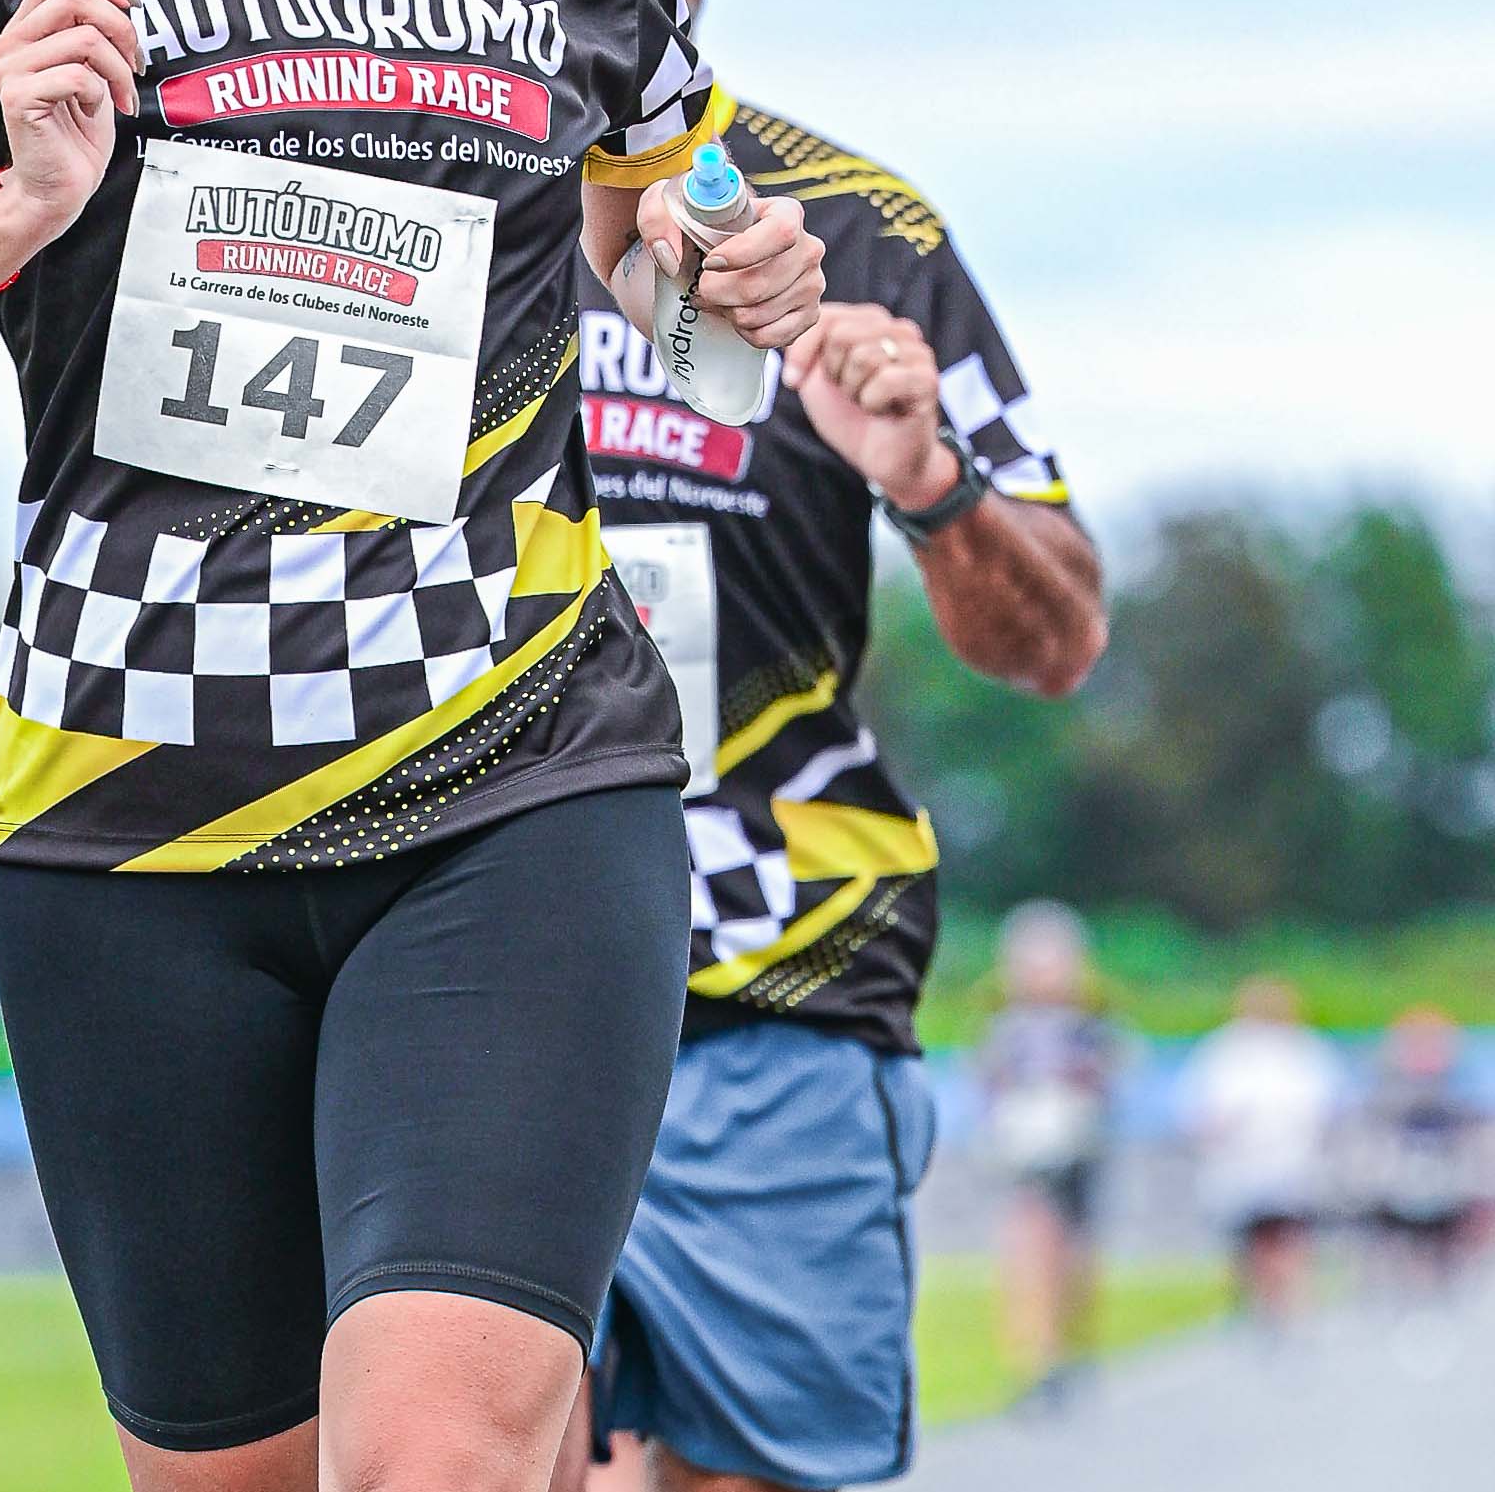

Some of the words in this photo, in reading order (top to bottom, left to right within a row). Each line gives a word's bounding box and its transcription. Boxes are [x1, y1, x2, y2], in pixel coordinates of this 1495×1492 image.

[205, 56, 398, 114] RUNNING
[407, 66, 512, 125] RACE
[269, 130, 301, 157] de
[307, 130, 345, 157] los
[350, 132, 433, 161] Clubes
[440, 134, 480, 163] del
[186, 181, 442, 272] AUTÓDROMO
[169, 272, 186, 288] La
[190, 276, 243, 297] Carrera
[247, 285, 266, 301] de
[269, 288, 290, 305] los
[292, 293, 341, 314] Clubes
[343, 301, 365, 318] del
[368, 306, 430, 330] Noroeste
[222, 245, 327, 279] RUNNING
[332, 258, 394, 298] RACE
[160, 320, 415, 447] 147
[600, 401, 710, 468] RACE
